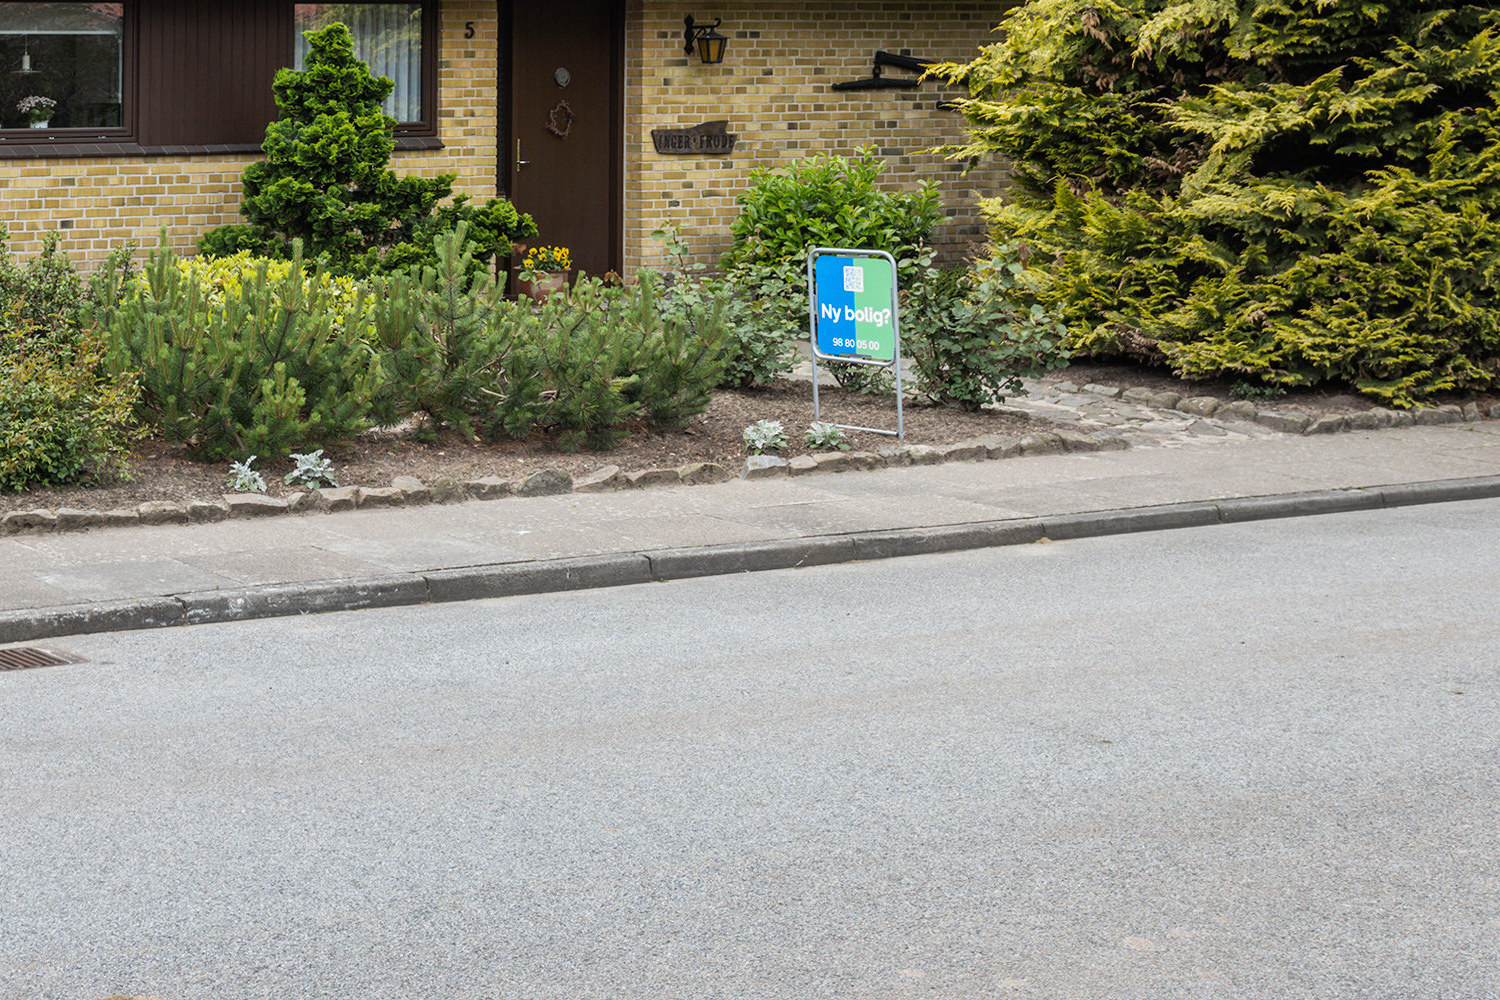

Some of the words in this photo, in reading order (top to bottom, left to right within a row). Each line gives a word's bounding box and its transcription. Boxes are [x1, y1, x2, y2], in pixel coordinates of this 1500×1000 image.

[464, 21, 475, 39] 5
[658, 135, 690, 149] INGER
[699, 134, 735, 148] FRODE
[821, 303, 841, 323] Ny
[844, 305, 891, 327] bolig?
[832, 337, 843, 347] 98
[844, 338, 855, 348] 80
[857, 339, 867, 350] 05
[869, 341, 880, 351] 00
